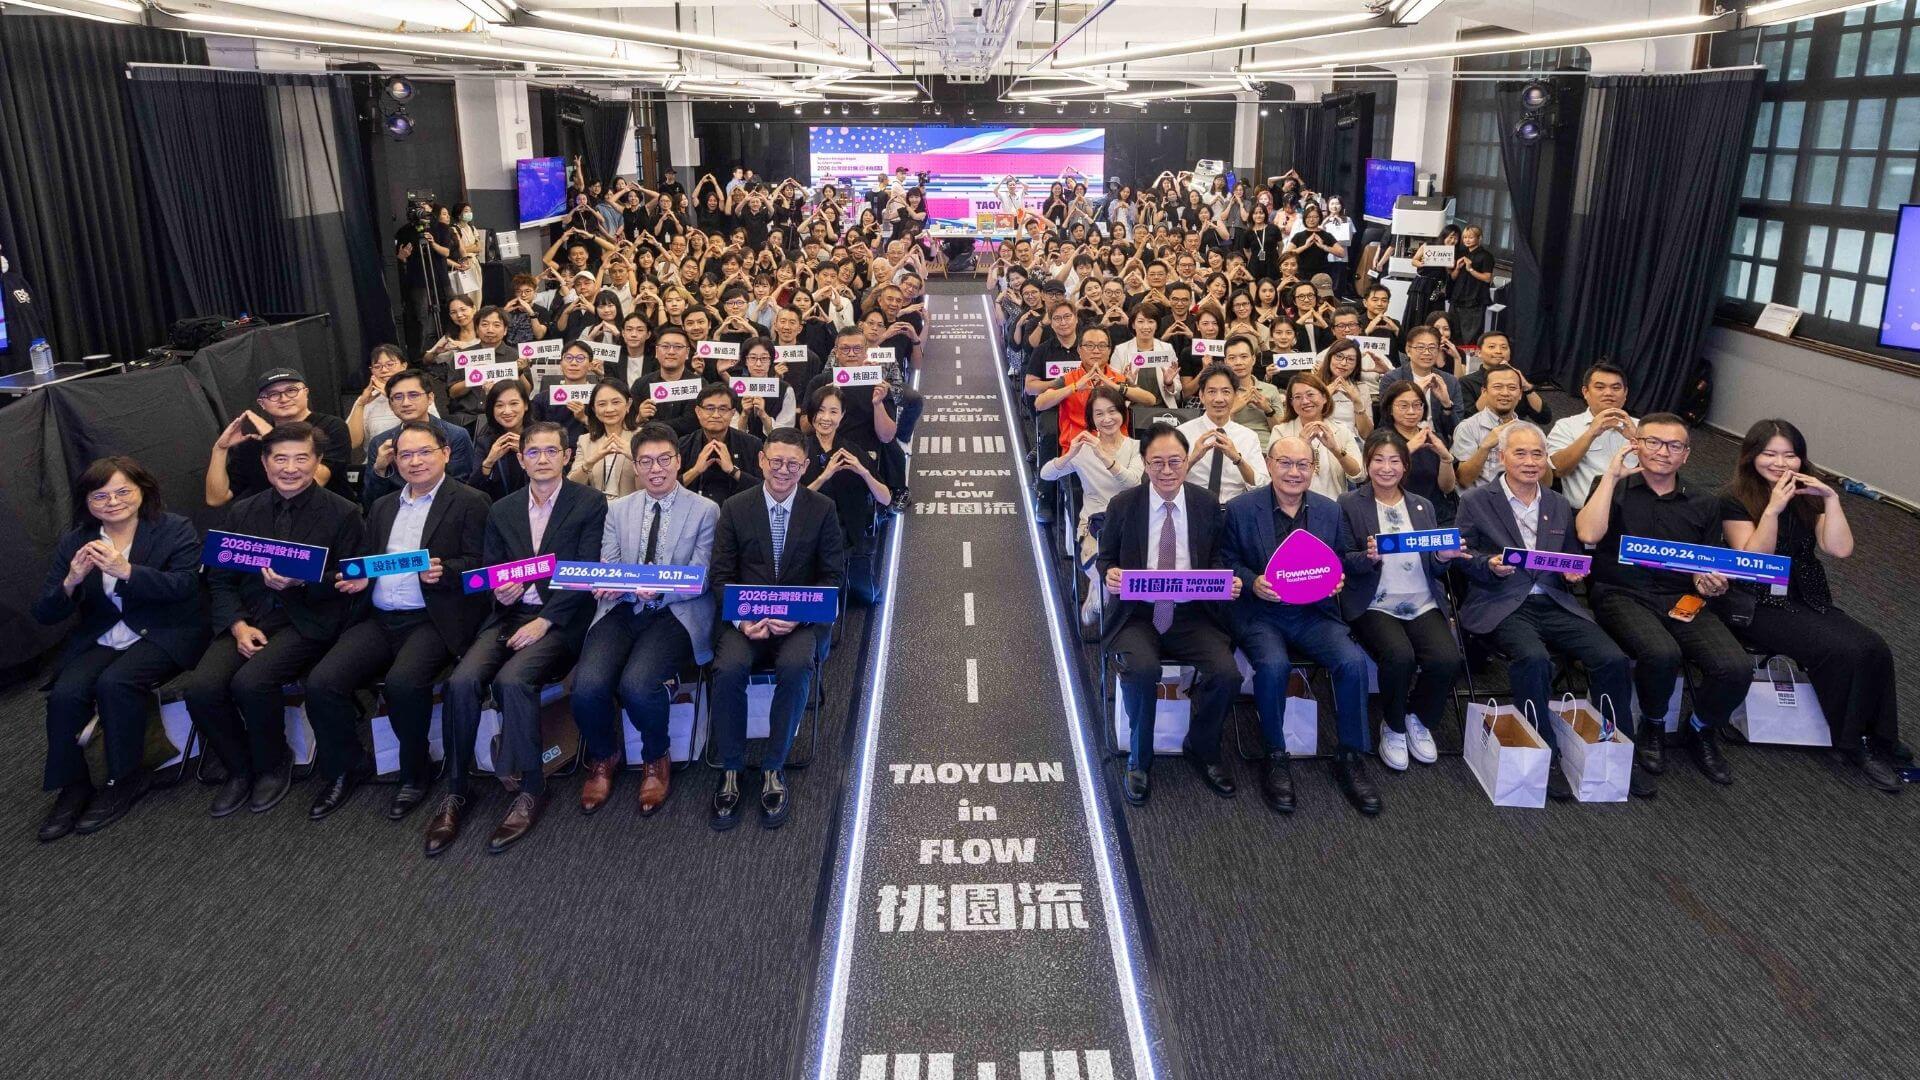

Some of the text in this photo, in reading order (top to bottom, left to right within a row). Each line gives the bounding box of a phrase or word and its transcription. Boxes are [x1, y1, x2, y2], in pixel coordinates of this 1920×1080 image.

[976, 201, 1001, 209] TAOY
[1291, 358, 1314, 366] 文化流
[853, 370, 879, 381] 桃園流
[671, 385, 698, 396] 玩美流
[916, 469, 1011, 477] TAOYUAN
[915, 502, 1017, 515] 桃園流
[1406, 534, 1454, 548] 中壢展區
[220, 537, 311, 561] 2026台灣設計展
[1626, 542, 1695, 560] 2026.09.24
[1736, 556, 1764, 570] 10.11
[1534, 556, 1584, 570] 衛星展區
[496, 560, 550, 582] 青埔展區
[559, 566, 622, 578] 2026.09.24
[658, 571, 682, 580] 10.11
[1129, 578, 1183, 592] 桃園流
[738, 590, 824, 602] 2026台灣設計展
[889, 762, 1065, 784] TAOYUAN
[958, 799, 998, 822] in
[920, 838, 1036, 865] FLOW
[876, 882, 1089, 932] 桃園流
